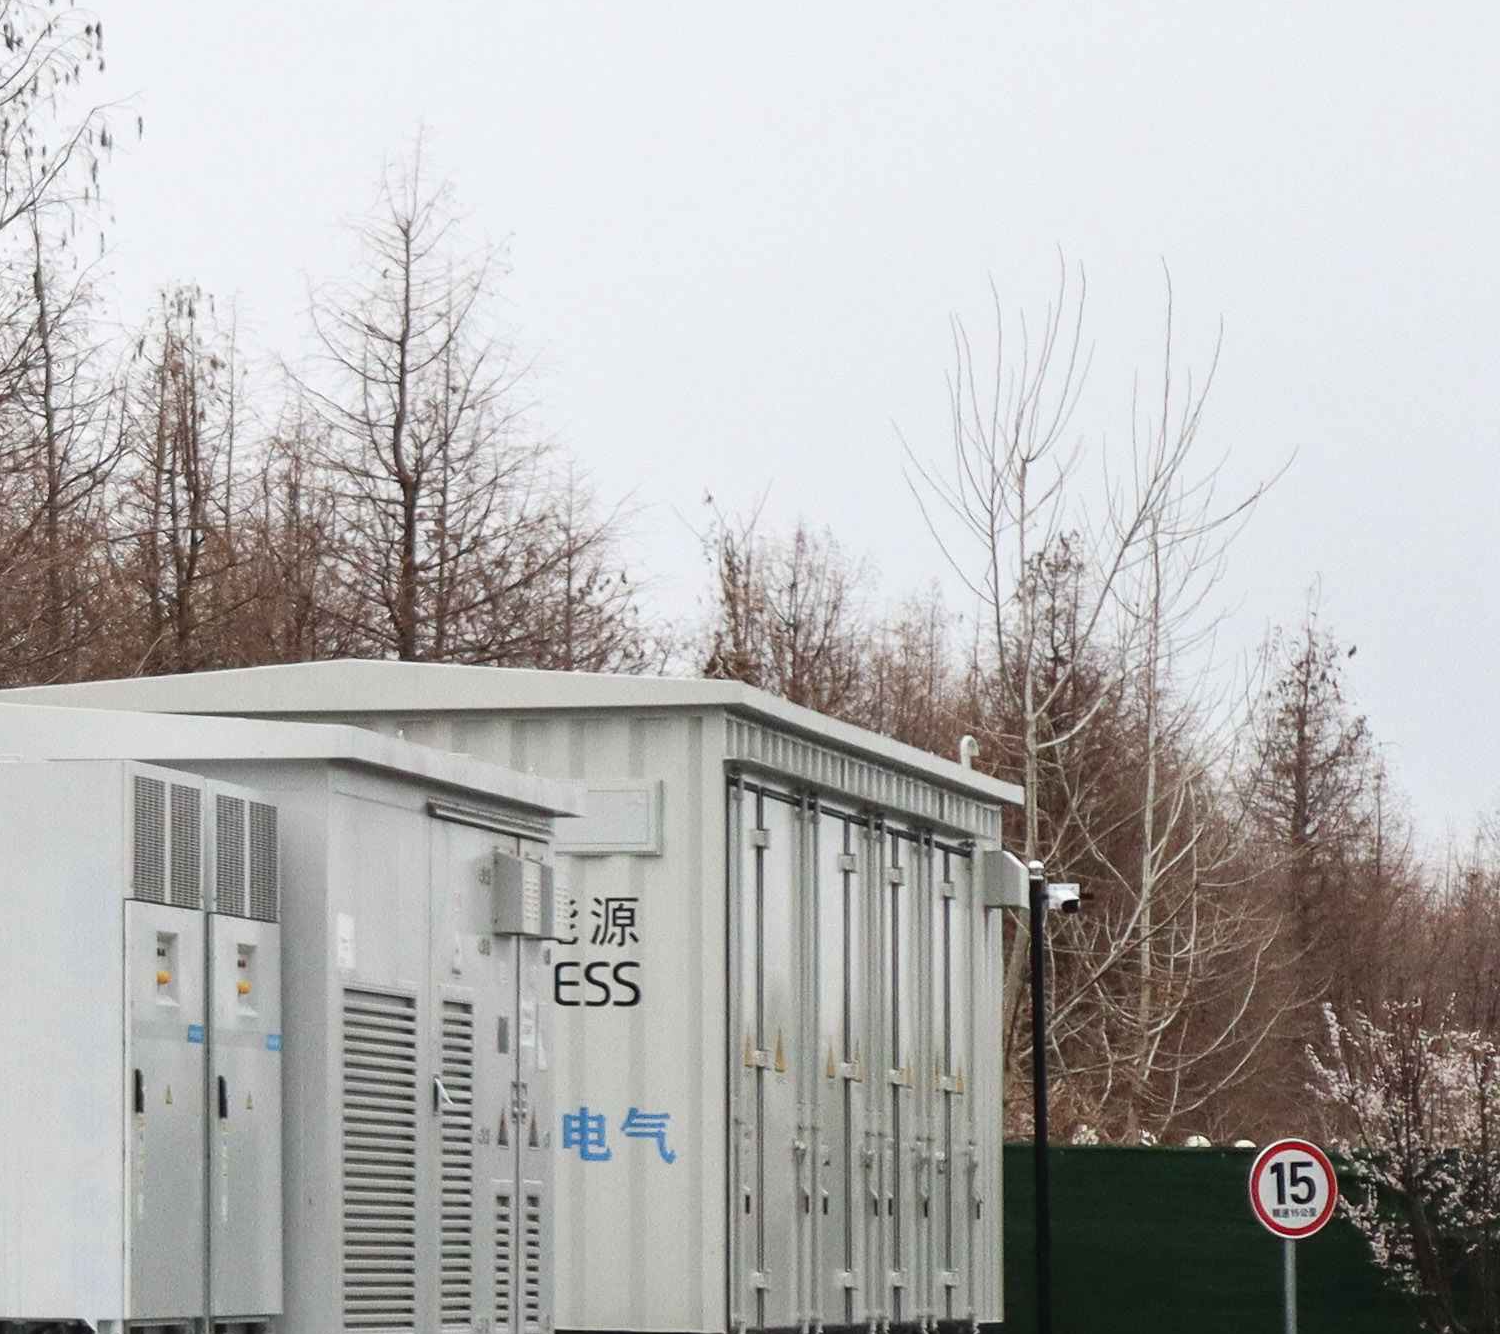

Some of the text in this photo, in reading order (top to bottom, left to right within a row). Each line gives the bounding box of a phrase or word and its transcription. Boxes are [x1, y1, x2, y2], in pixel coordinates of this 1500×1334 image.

[554, 961, 641, 1007] ESS
[563, 1106, 677, 1165] 电气
[1269, 1160, 1317, 1206] 15
